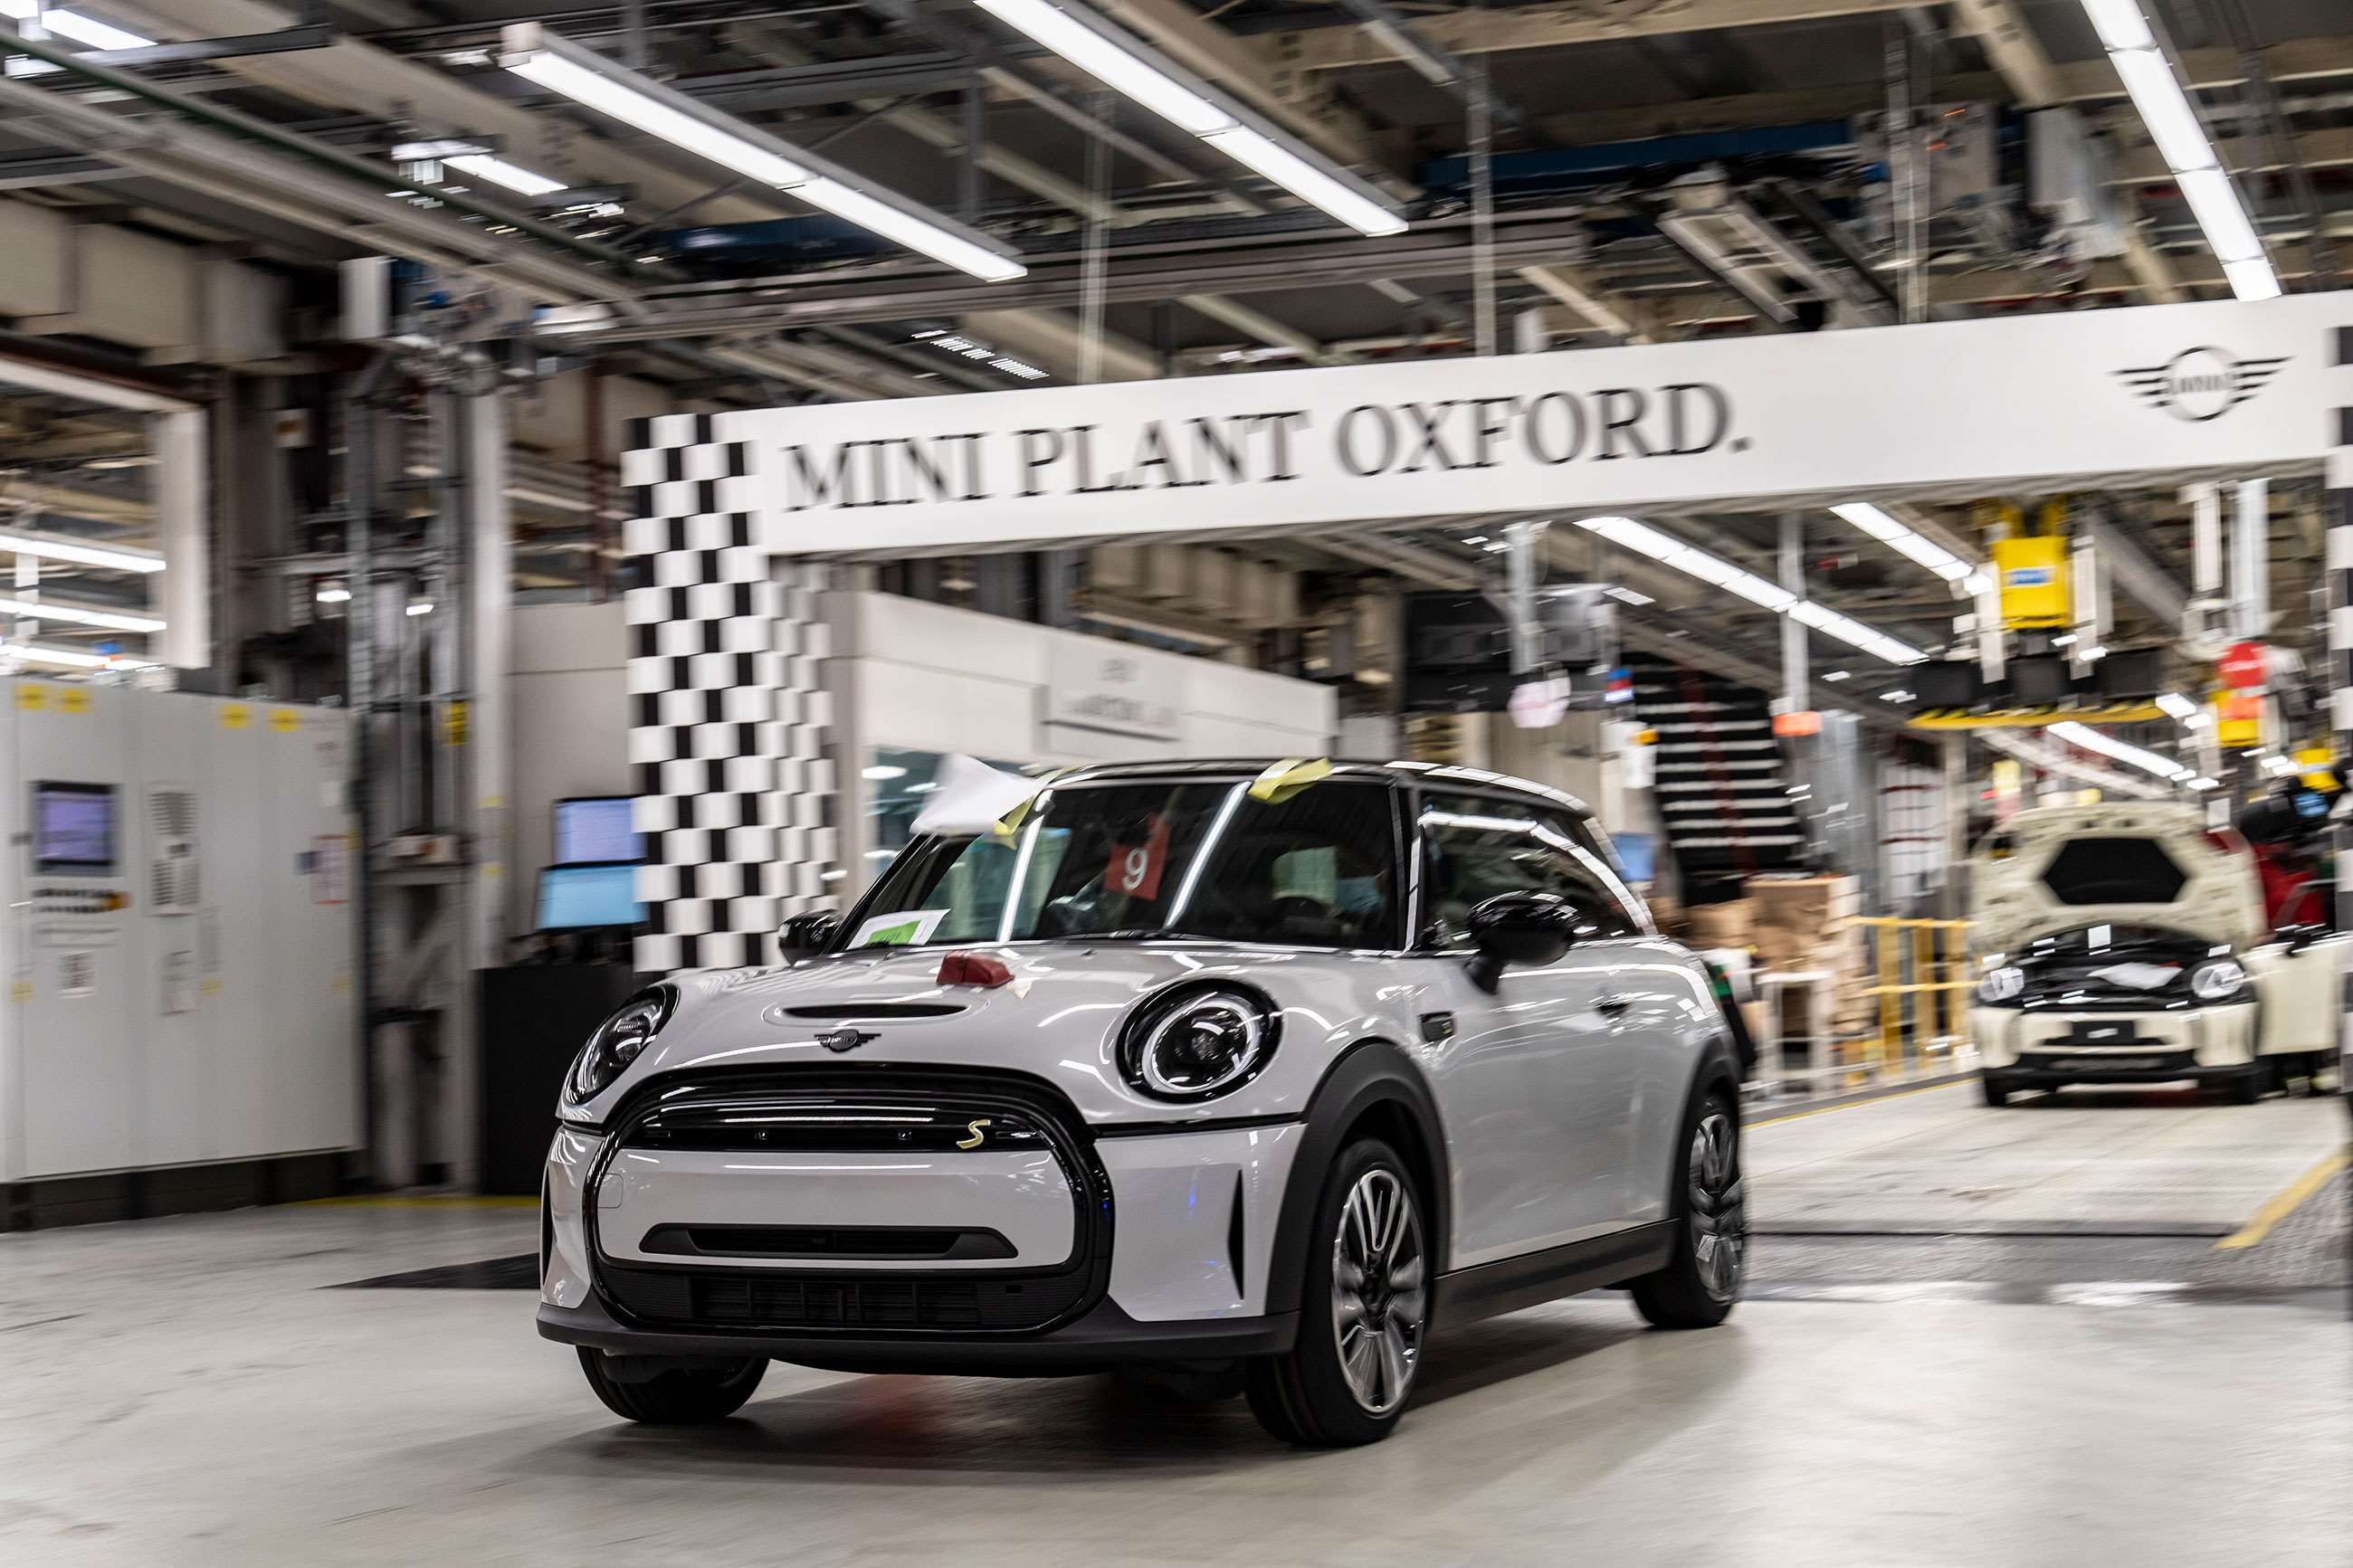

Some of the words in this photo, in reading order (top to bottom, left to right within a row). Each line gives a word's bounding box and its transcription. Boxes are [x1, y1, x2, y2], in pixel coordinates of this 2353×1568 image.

[782, 429, 992, 512] MINI
[1014, 400, 1309, 498] PLANT
[1335, 381, 1754, 477] OXFORD.
[1122, 847, 1148, 891] 9
[956, 1118, 991, 1149] S
